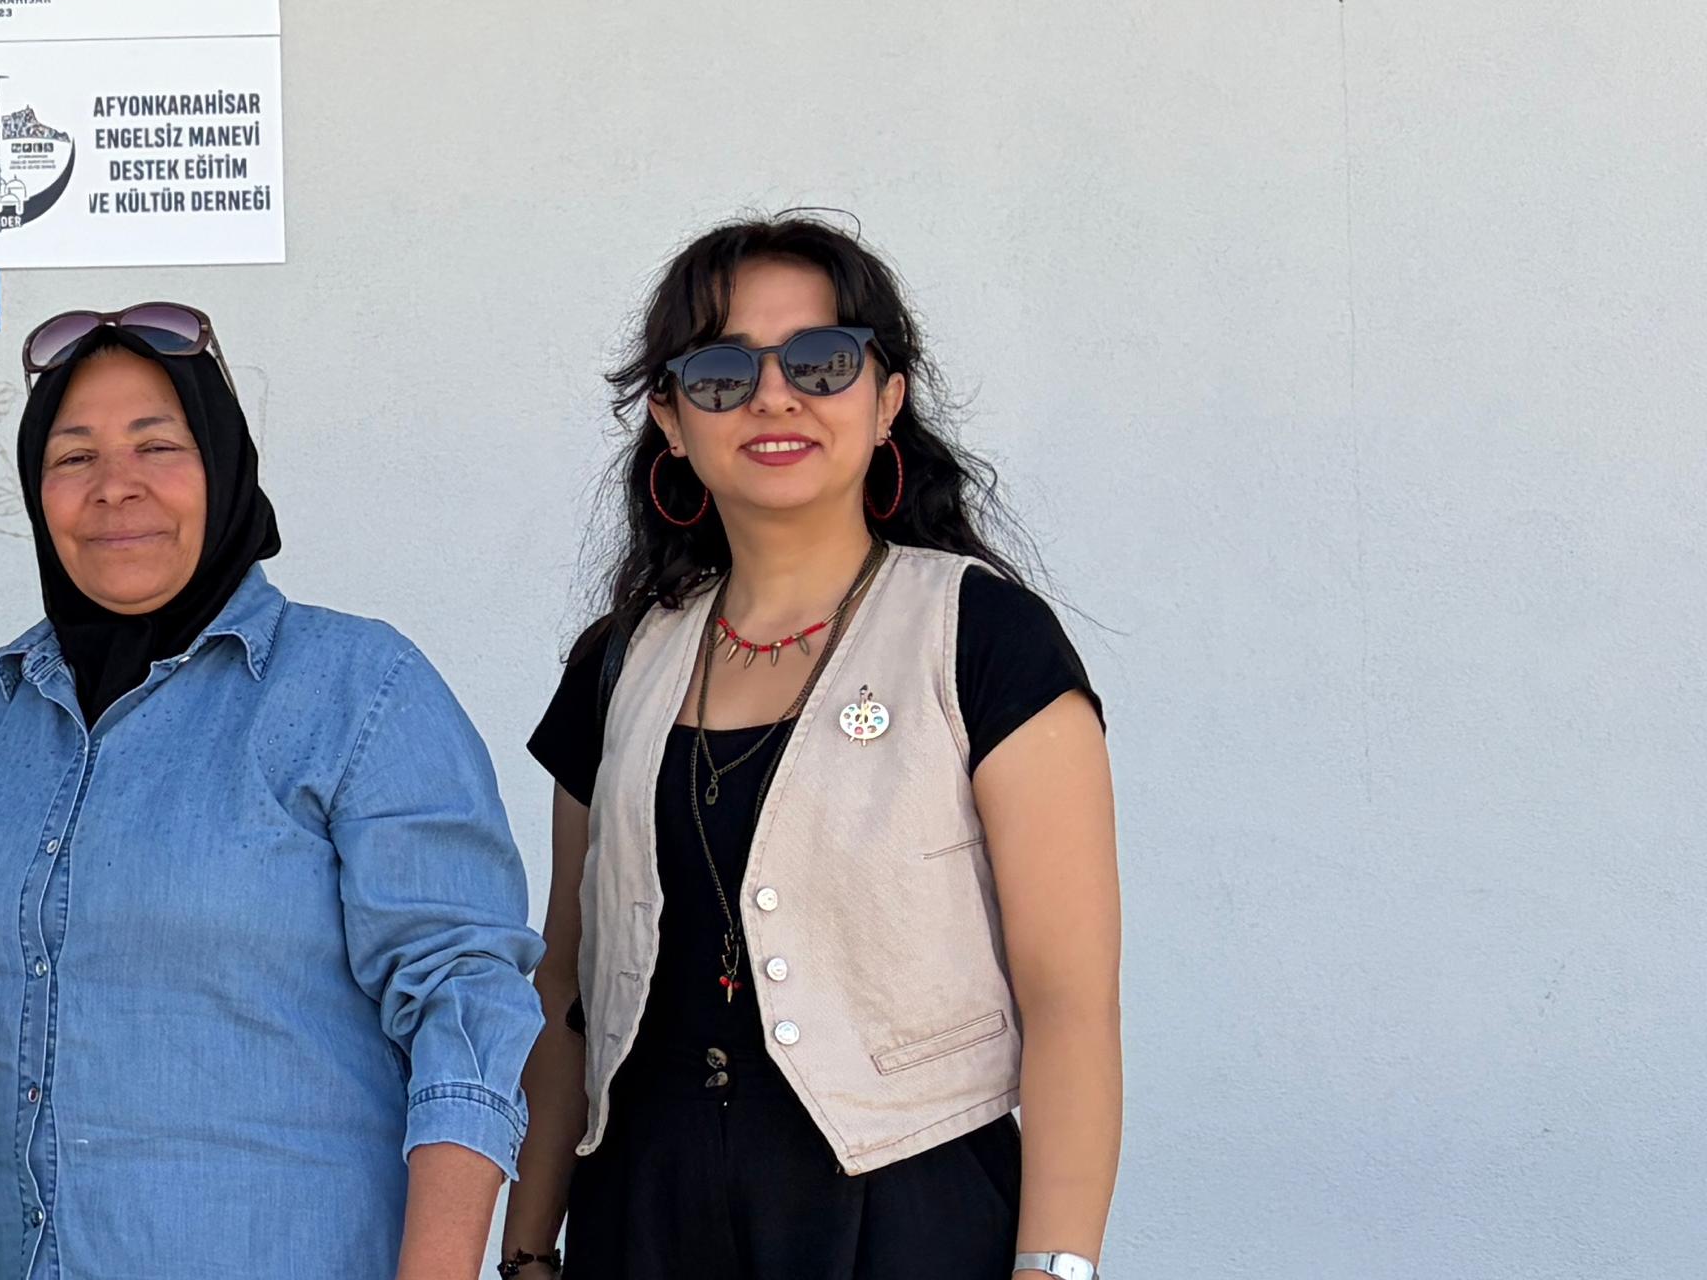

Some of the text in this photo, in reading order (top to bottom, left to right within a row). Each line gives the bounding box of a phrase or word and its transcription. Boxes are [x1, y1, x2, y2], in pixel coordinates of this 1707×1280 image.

[93, 89, 260, 117] AFYONKARAHİSAR
[95, 121, 260, 149] ENGELSİZ MANEVİ
[110, 153, 247, 181] DESTEK EĞİTİM
[89, 185, 271, 214] VE KÜLTÜR DERNEĞİ
